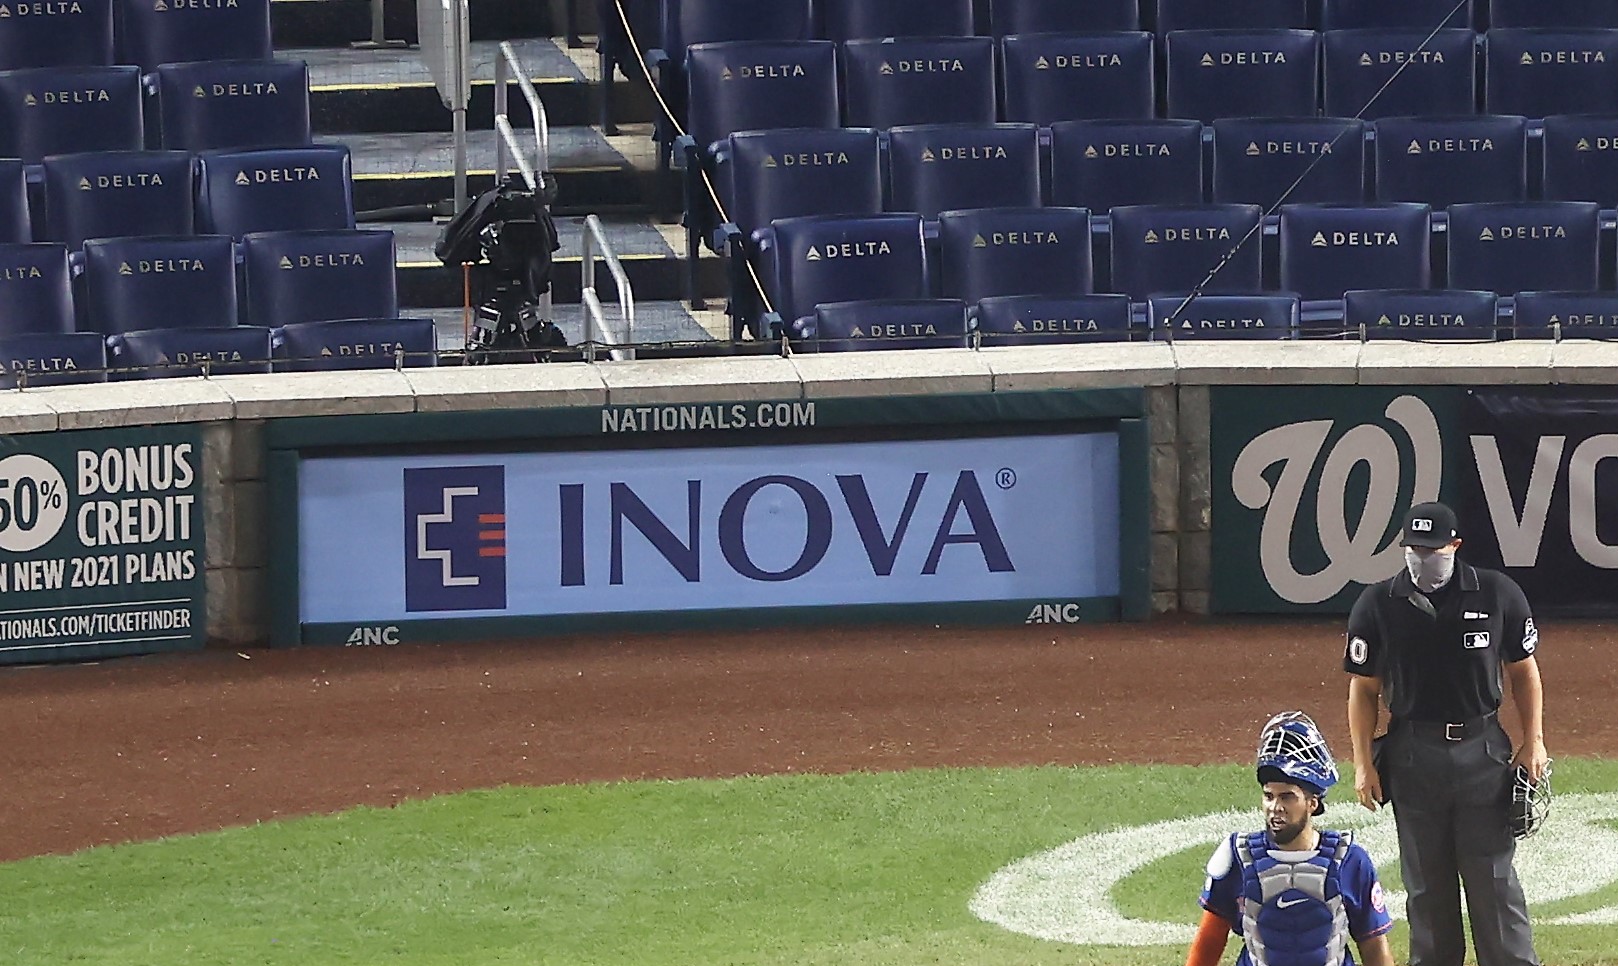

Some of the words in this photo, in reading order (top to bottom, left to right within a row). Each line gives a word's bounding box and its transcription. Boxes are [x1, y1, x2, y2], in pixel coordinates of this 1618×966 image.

[18, 3, 82, 16] DELTA
[1056, 55, 1122, 67] DELTA
[1221, 51, 1286, 66] DELTA
[1380, 51, 1444, 64] DELTA
[1541, 50, 1605, 64] DELTA
[740, 64, 804, 78] DELTA
[899, 60, 963, 72] DELTA
[212, 83, 278, 95] DELTA
[45, 90, 110, 103] DELTA
[1104, 143, 1170, 157] DELTA
[1266, 142, 1331, 153] DELTA
[1428, 138, 1493, 152] DELTA
[784, 152, 849, 166] DELTA
[941, 147, 1006, 159] DELTA
[98, 174, 162, 188] DELTA
[255, 168, 319, 183] DELTA
[993, 232, 1058, 245] DELTA
[1165, 228, 1230, 241] DELTA
[1333, 232, 1398, 247] DELTA
[1501, 226, 1566, 240] DELTA
[826, 241, 890, 257] DELTA
[139, 260, 204, 273] DELTA
[300, 254, 364, 267] DELTA
[0, 265, 42, 278] LTA
[1032, 320, 1097, 331] DELTA
[1399, 314, 1465, 327] DELTA
[871, 324, 936, 336] DELTA
[11, 358, 76, 373] DELTA
[602, 402, 815, 432] NATIONALS.COM
[77, 444, 194, 496] BONUS
[77, 495, 194, 547] CREDIT
[14, 559, 65, 591] NEW
[71, 554, 119, 588] 2021
[126, 550, 195, 583] PLANS
[1025, 603, 1080, 624] ANC
[345, 626, 400, 647] ANC
